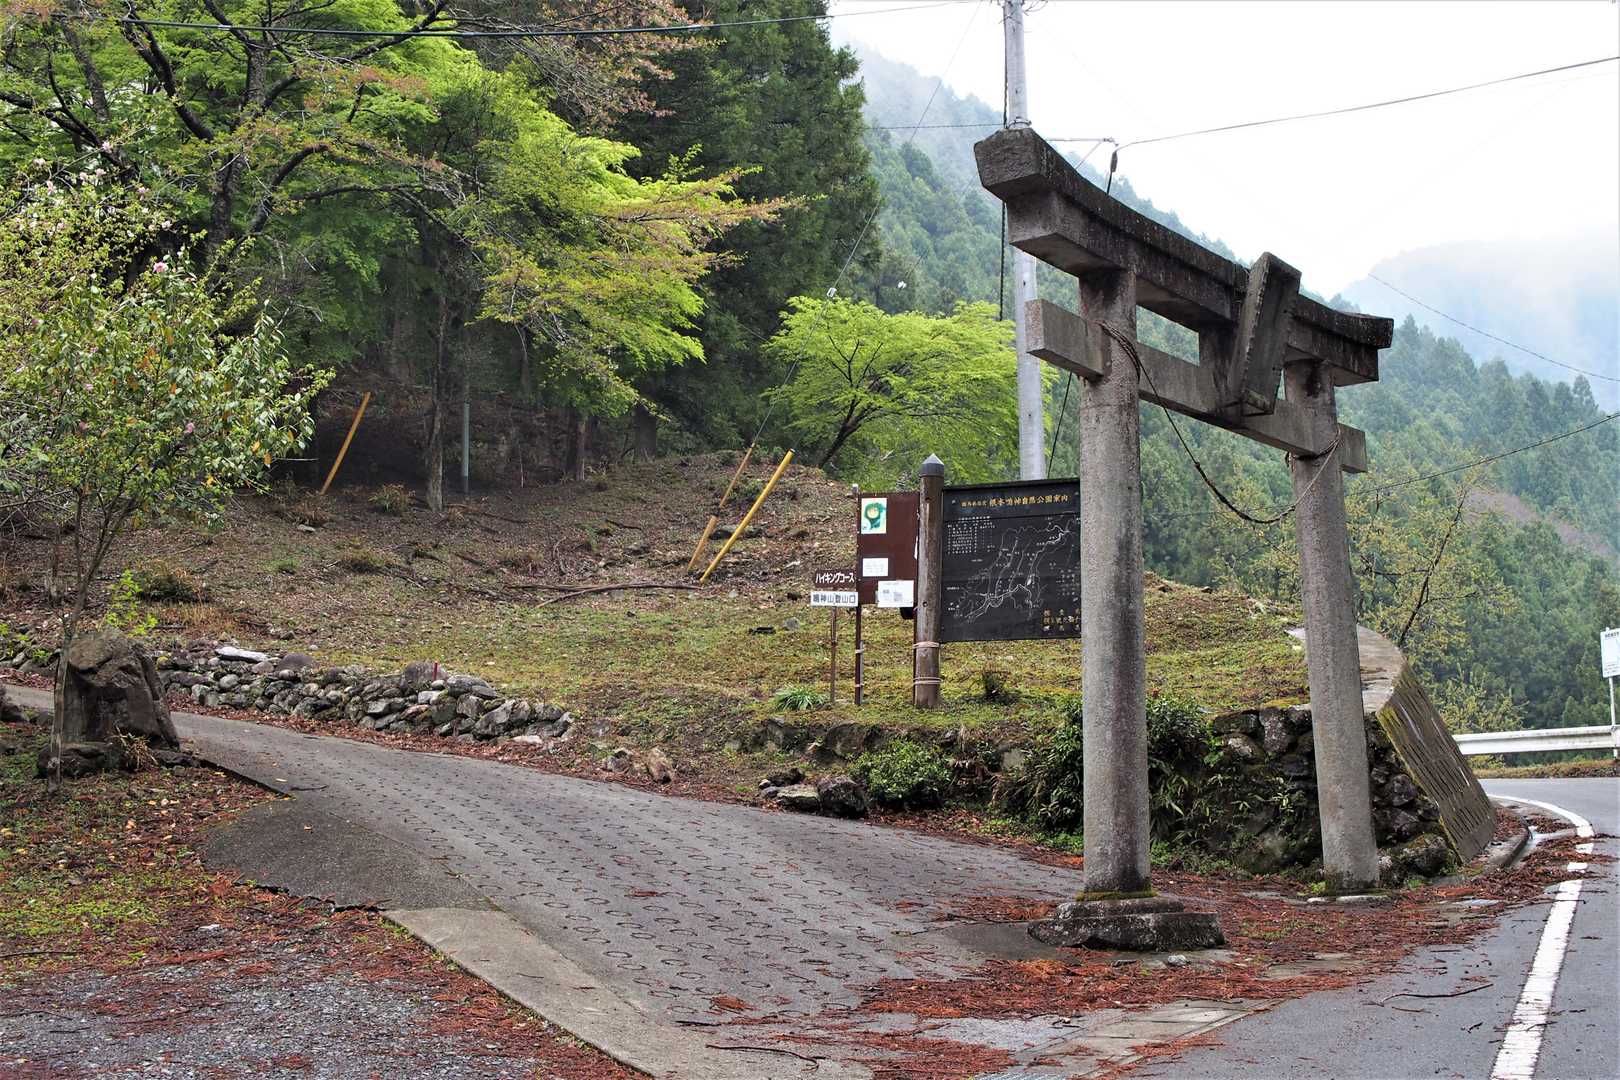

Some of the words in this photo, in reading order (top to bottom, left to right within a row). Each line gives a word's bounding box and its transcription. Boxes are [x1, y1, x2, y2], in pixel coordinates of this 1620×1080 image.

[815, 571, 855, 583] ハイキングコース
